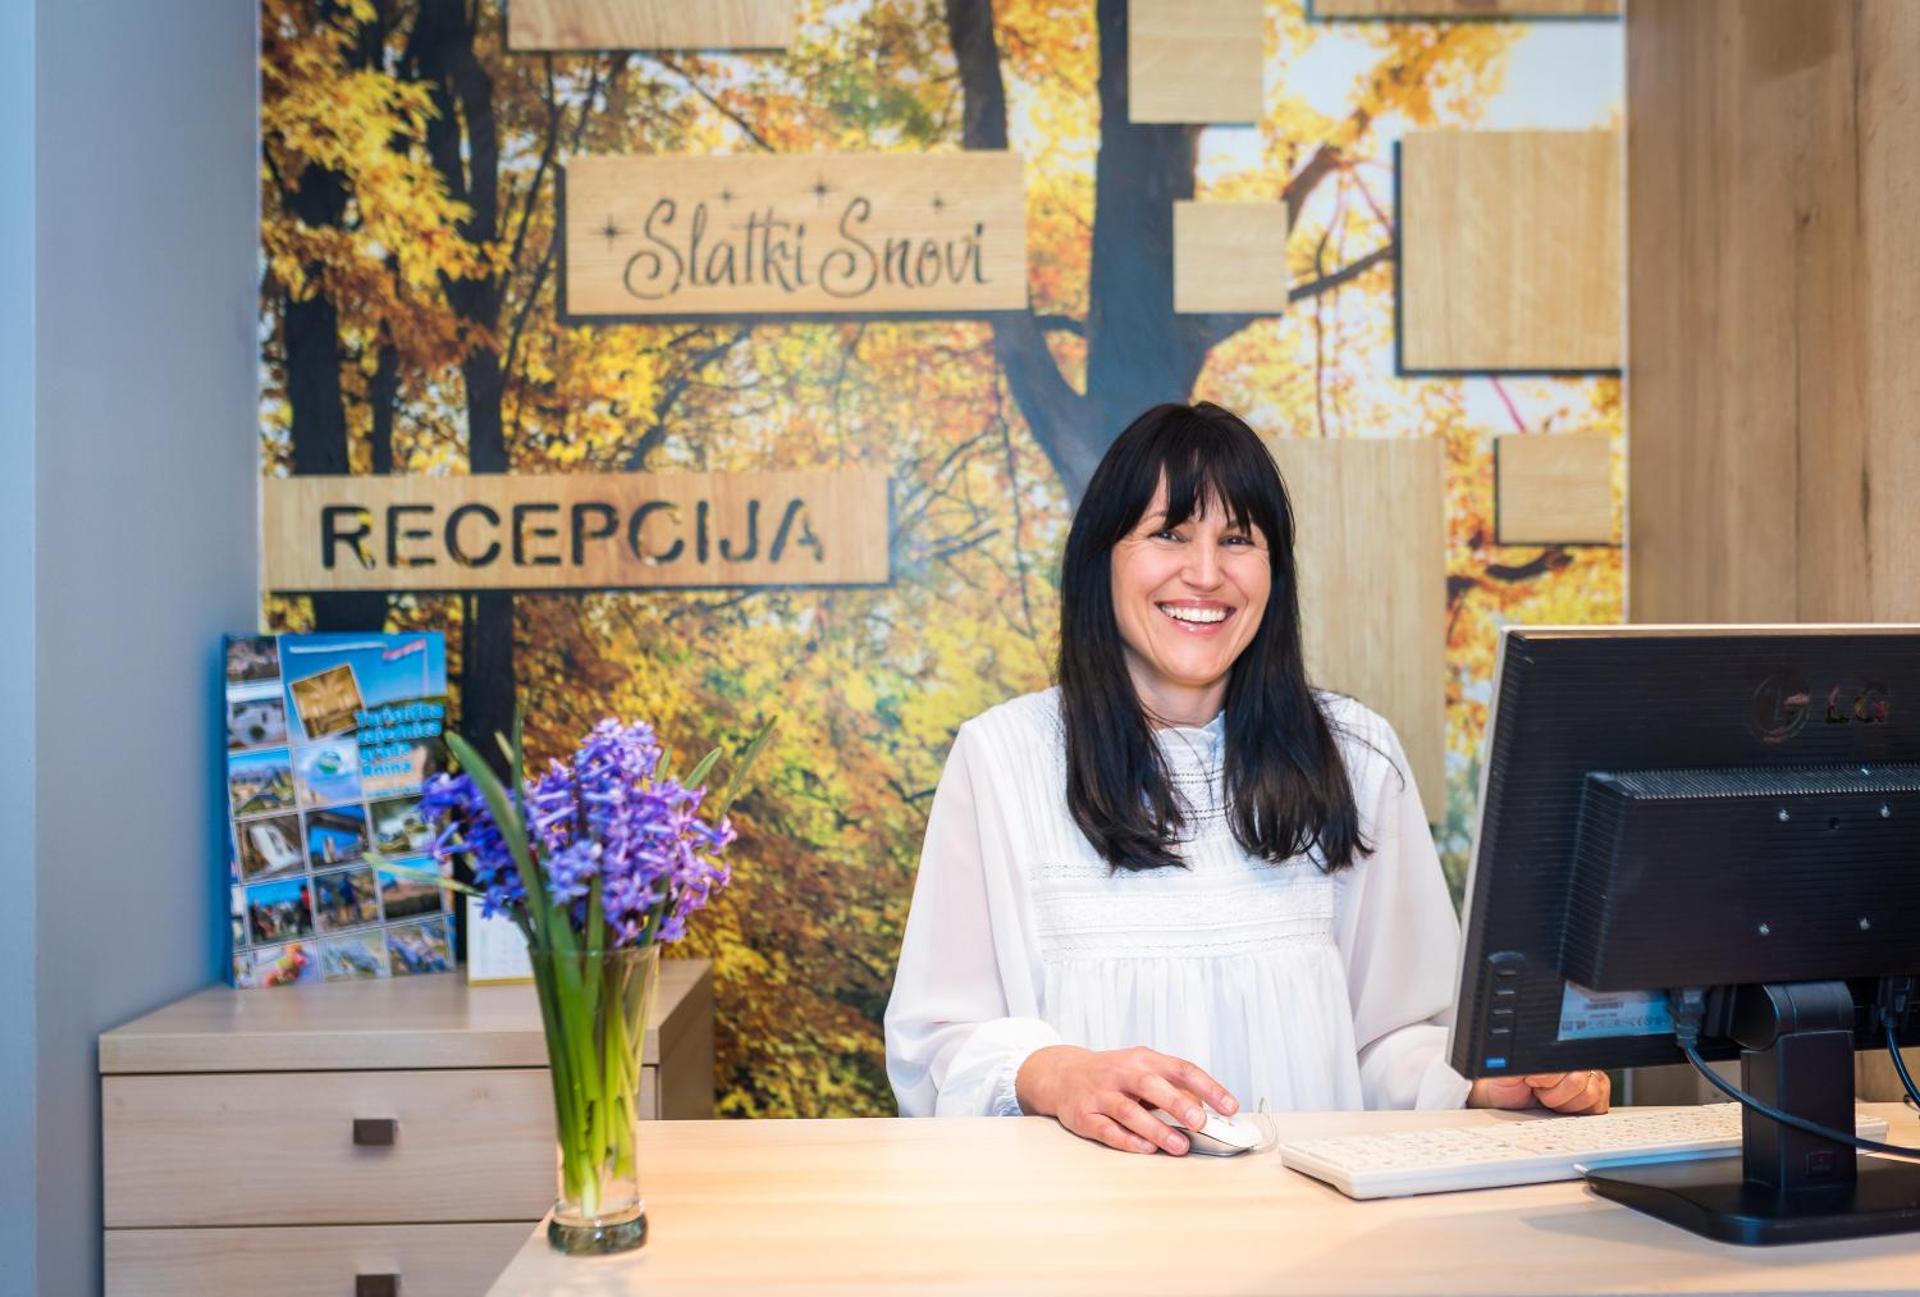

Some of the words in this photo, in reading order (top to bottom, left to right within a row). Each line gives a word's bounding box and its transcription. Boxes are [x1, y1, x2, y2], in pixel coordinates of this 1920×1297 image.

[623, 197, 809, 300] Slatki
[819, 197, 993, 299] Snovi
[320, 500, 825, 569] RECEPCIJA
